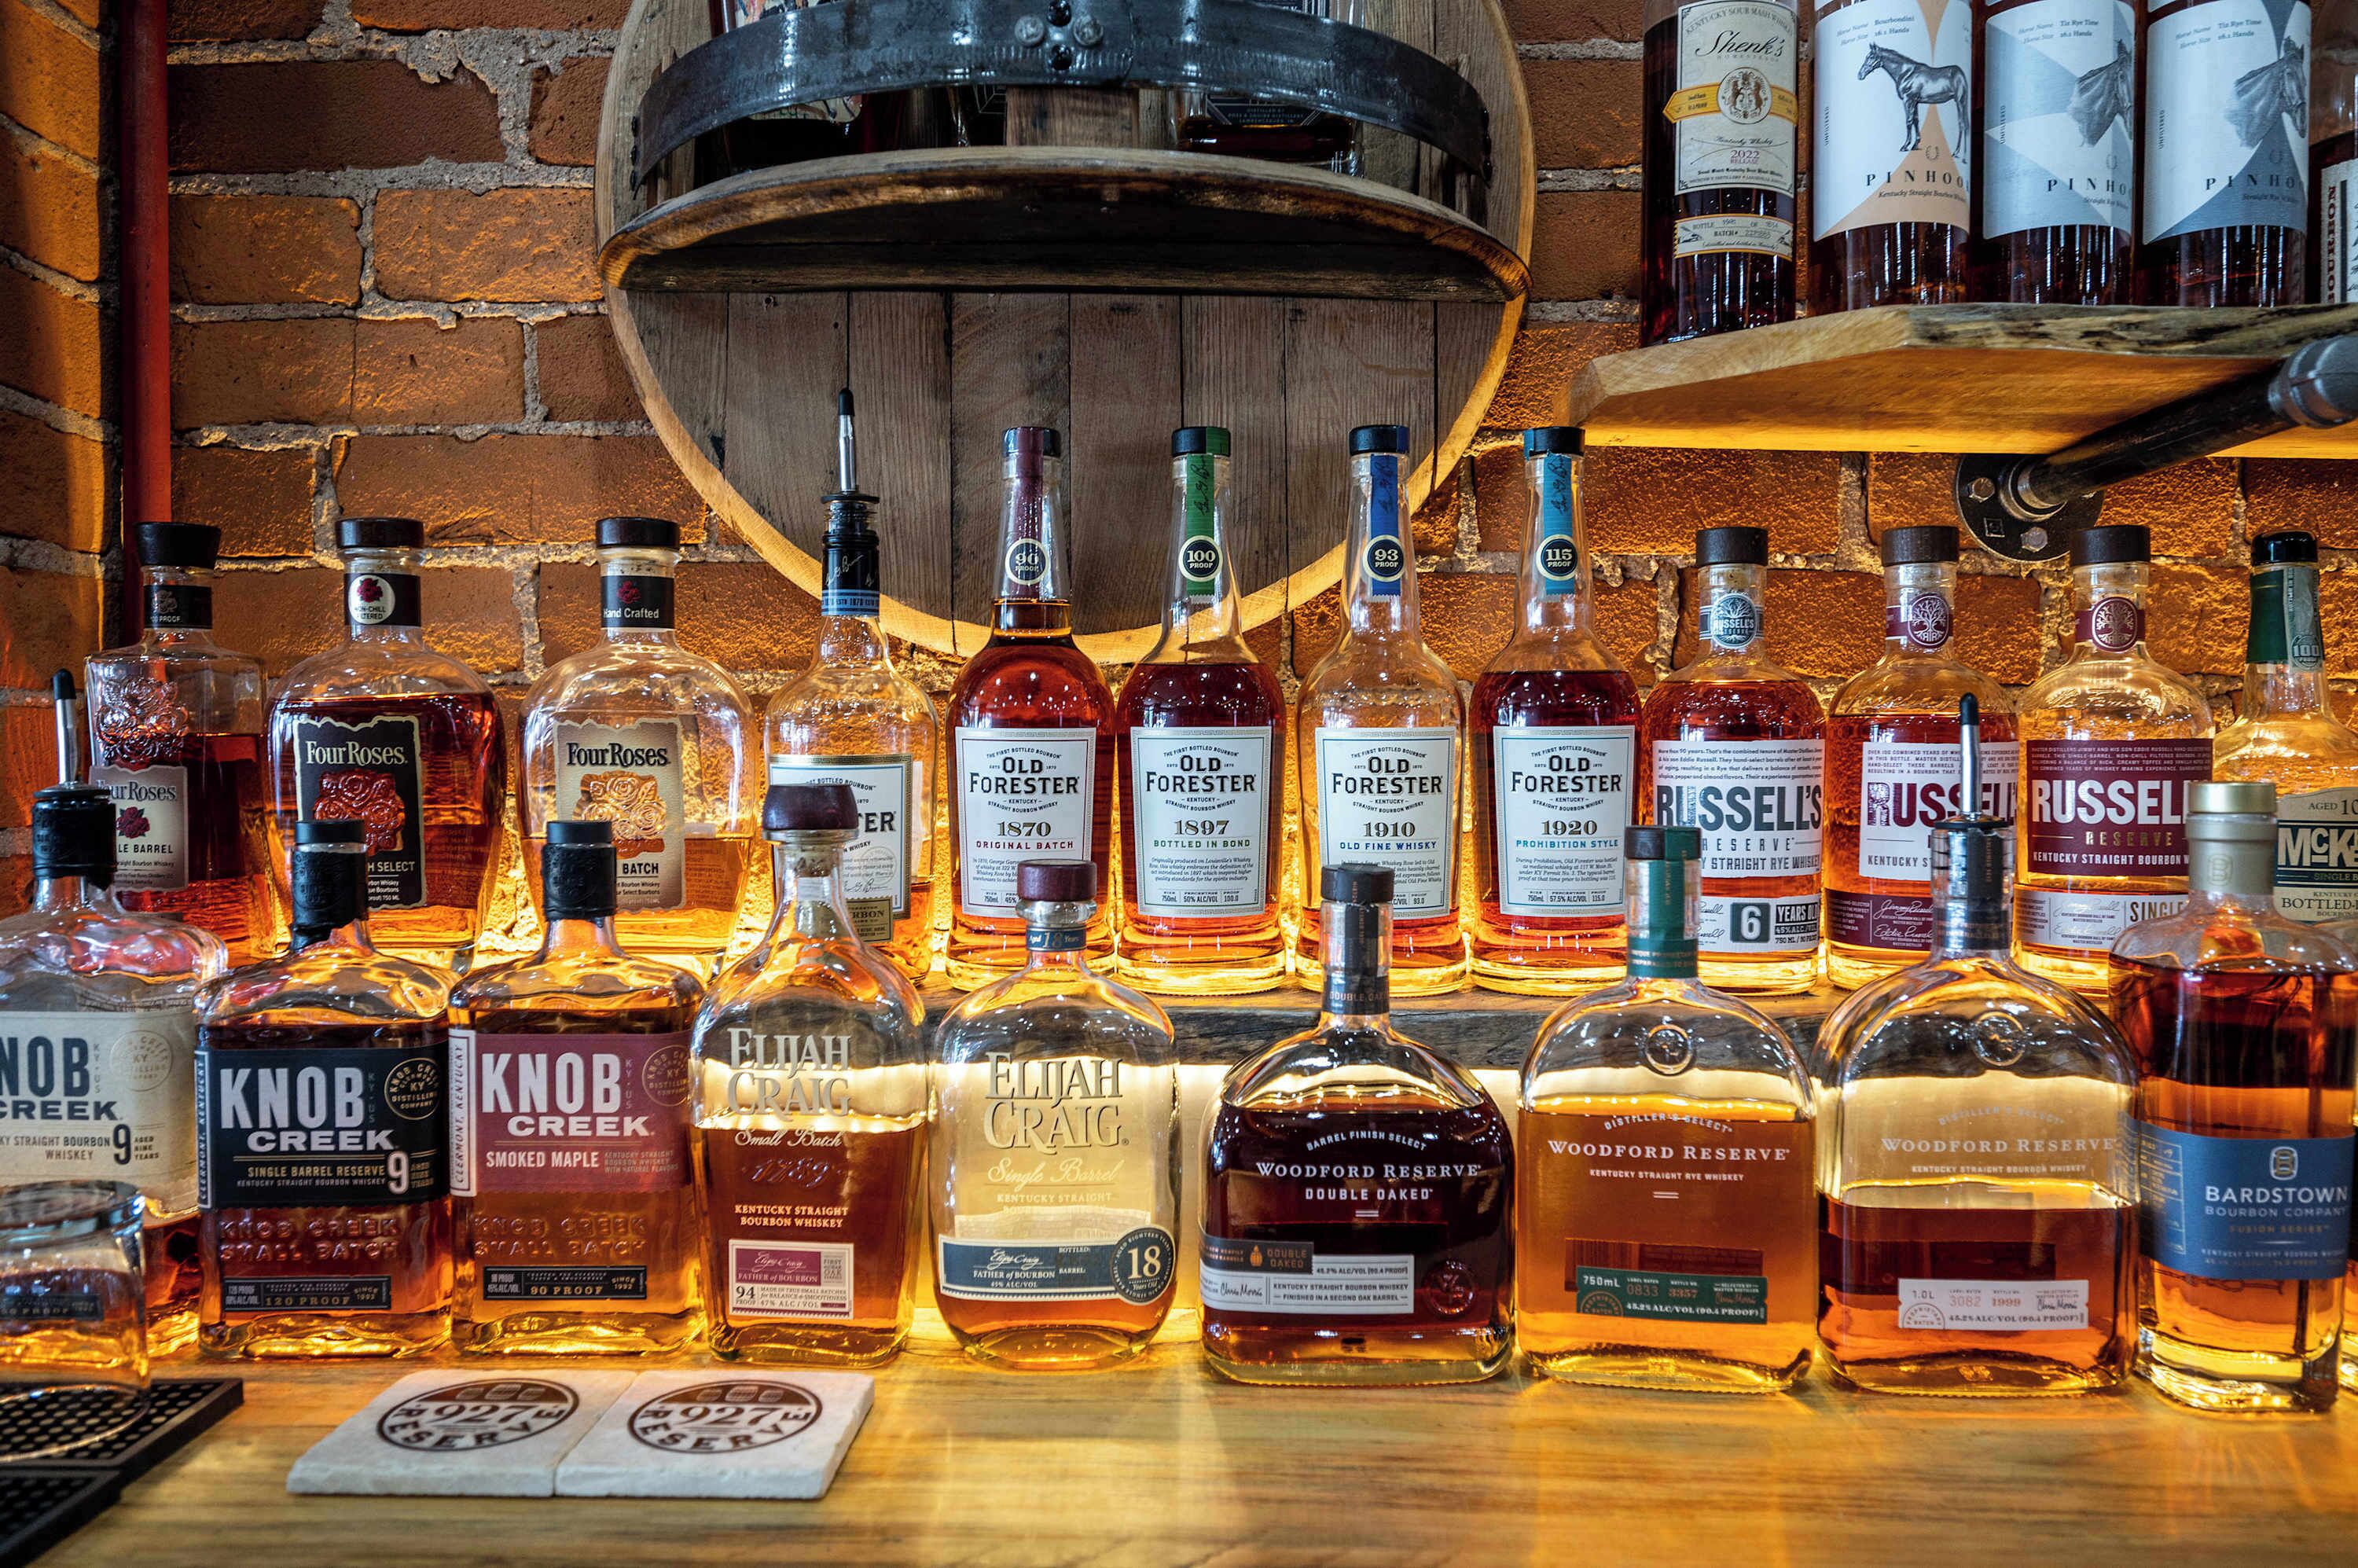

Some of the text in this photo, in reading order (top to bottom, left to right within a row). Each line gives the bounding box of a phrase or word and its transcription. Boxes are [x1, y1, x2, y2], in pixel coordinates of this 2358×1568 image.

[1695, 30, 1785, 57] Shenk's
[1731, 149, 1760, 159] 2022
[1865, 170, 1970, 192] PINHOO
[2047, 177, 2132, 196] PINHO
[2206, 174, 2305, 190] PINHO
[1016, 553, 1039, 566] 90
[1186, 549, 1215, 562] 100
[1375, 549, 1399, 560] 93
[1545, 549, 1573, 560] 115
[603, 608, 659, 619] Hand Crafted
[1713, 619, 1754, 630] RUSSELL'S
[2293, 644, 2319, 656] 100
[1002, 756, 1043, 773] OLD
[1180, 755, 1221, 772] OLD
[1368, 756, 1409, 773] OLD
[1548, 755, 1589, 772] OLD
[969, 773, 1079, 794] FORESTER
[1146, 771, 1256, 792] FORESTER
[1332, 773, 1442, 794] FORESTER
[1511, 771, 1622, 792] FORESTER
[988, 800, 1012, 812] STRAIGHT
[1038, 800, 1058, 811] WHISKY
[1165, 799, 1189, 810] STRAIGHT
[1217, 799, 1236, 810] WHISKY
[1657, 784, 1821, 831] RUSSELL'S
[2032, 780, 2188, 824] RUSSEL
[2308, 802, 2338, 810] AGED
[997, 821, 1051, 837] 1870
[1174, 820, 1230, 835] 1897
[1363, 821, 1416, 837] 1910
[1541, 820, 1597, 835] 1920
[976, 840, 1074, 850] ORIGINAL BATCH
[1154, 839, 1201, 848] BOTTLED
[1222, 839, 1251, 848] BOND
[1364, 842, 1391, 850] FINE
[1396, 841, 1437, 850] WHISKY
[1516, 839, 1618, 848] PROHIBITION STYLE
[2085, 831, 2173, 846] RESERVE
[133, 843, 174, 854] BARREL
[1711, 858, 1765, 870] STRAIGHT
[1770, 857, 1789, 869] RYE
[1868, 855, 1919, 867] KENTUCKY
[2033, 852, 2181, 865] KENTUCKY STRAIGHT BOURBON
[377, 861, 415, 872] SELECT
[622, 863, 659, 875] BATCH
[1740, 905, 1806, 940] 6 YEARS
[727, 1027, 852, 1078] ELIJAH
[0, 1036, 90, 1098] NOB
[482, 1052, 621, 1114] KNOB
[985, 1052, 1123, 1108] ELIJAH
[220, 1067, 365, 1129] KNOB
[727, 1071, 850, 1122] CRAIG
[507, 1116, 651, 1137] CREEK
[983, 1100, 1123, 1155] CRAIG
[14, 1137, 110, 1148] STRAIGHT BOURBON
[112, 1124, 132, 1165] 9
[247, 1129, 395, 1151] CREEK
[734, 1126, 843, 1148] Small Batch
[1306, 1130, 1427, 1151] BARREL FINISH SELECT
[1548, 1140, 1787, 1161] WOODFORD RESERVE
[1881, 1138, 2114, 1152] WOODFORD RESERVE
[45, 1149, 94, 1161] WHISKEY
[486, 1151, 600, 1168] SMOKED MAPLE
[248, 1166, 385, 1178] SINGLE BARREL RESERVE
[387, 1150, 410, 1195] 9
[987, 1156, 1124, 1192] Single Barrel
[1256, 1162, 1478, 1178] WOODFORD RESERVE
[1589, 1169, 1743, 1181] KENTUCKY STRAIGHT RYE WHISKEY
[997, 1193, 1111, 1203] KENTUCKY STRAIGHT
[1306, 1188, 1430, 1201] DOUBLE OAKED
[2205, 1185, 2348, 1204] BARDSTOWN
[734, 1204, 849, 1217] KENTUCKY STRAIGHT
[2205, 1206, 2278, 1217] BOURBON
[740, 1217, 843, 1228] BOURBON WHISKEY
[1266, 1247, 1307, 1258] DOUBLE
[1127, 1245, 1161, 1280] 18
[1270, 1258, 1304, 1269] OAKED
[1583, 1275, 1621, 1287] 750mL
[531, 1286, 603, 1295] 90 PROOF
[736, 1286, 755, 1299] 94
[426, 1404, 540, 1424] 927
[672, 1405, 783, 1425] 927
